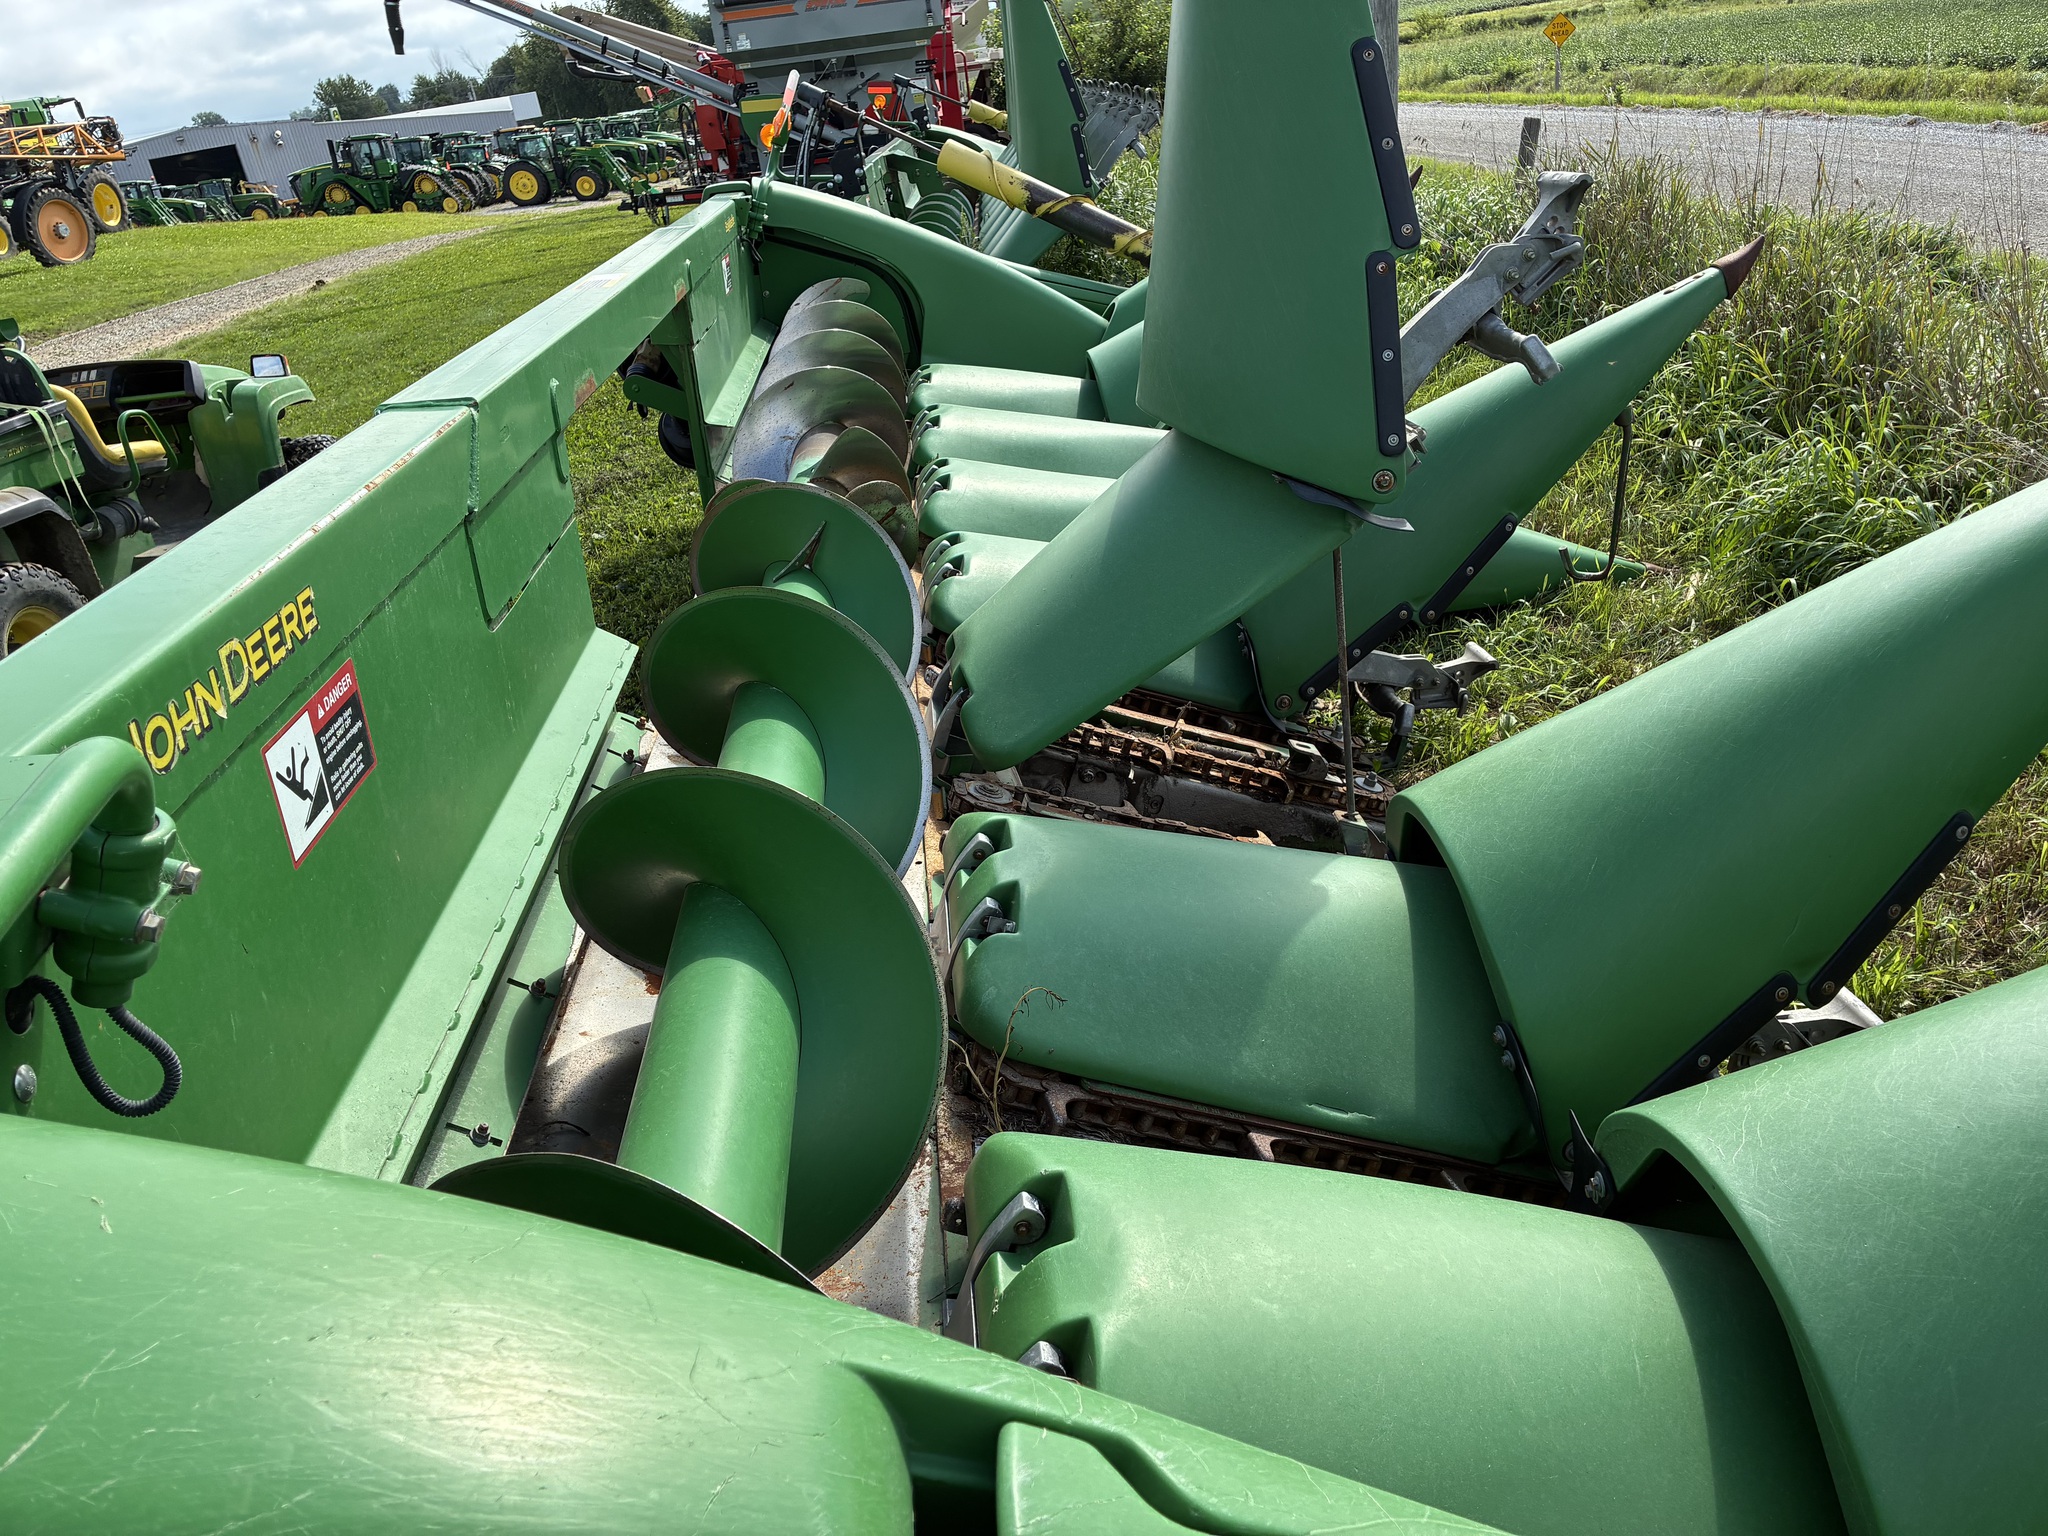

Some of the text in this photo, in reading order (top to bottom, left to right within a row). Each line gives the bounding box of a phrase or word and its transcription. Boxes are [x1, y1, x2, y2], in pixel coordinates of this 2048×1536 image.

[127, 585, 321, 776] JOHN DEERE
[323, 673, 352, 711] DANGER
[325, 725, 334, 740] avoid
[333, 716, 344, 730] bodily
[342, 706, 352, 720] injury
[336, 722, 345, 739] SHUT
[326, 749, 337, 764] engine
[335, 738, 346, 752] before
[330, 770, 339, 784] Rolls
[341, 750, 356, 771] gathering
[355, 741, 363, 753] units
[332, 779, 342, 792] move
[341, 768, 350, 782] faster
[349, 760, 357, 772] than
[344, 775, 354, 789] loose
